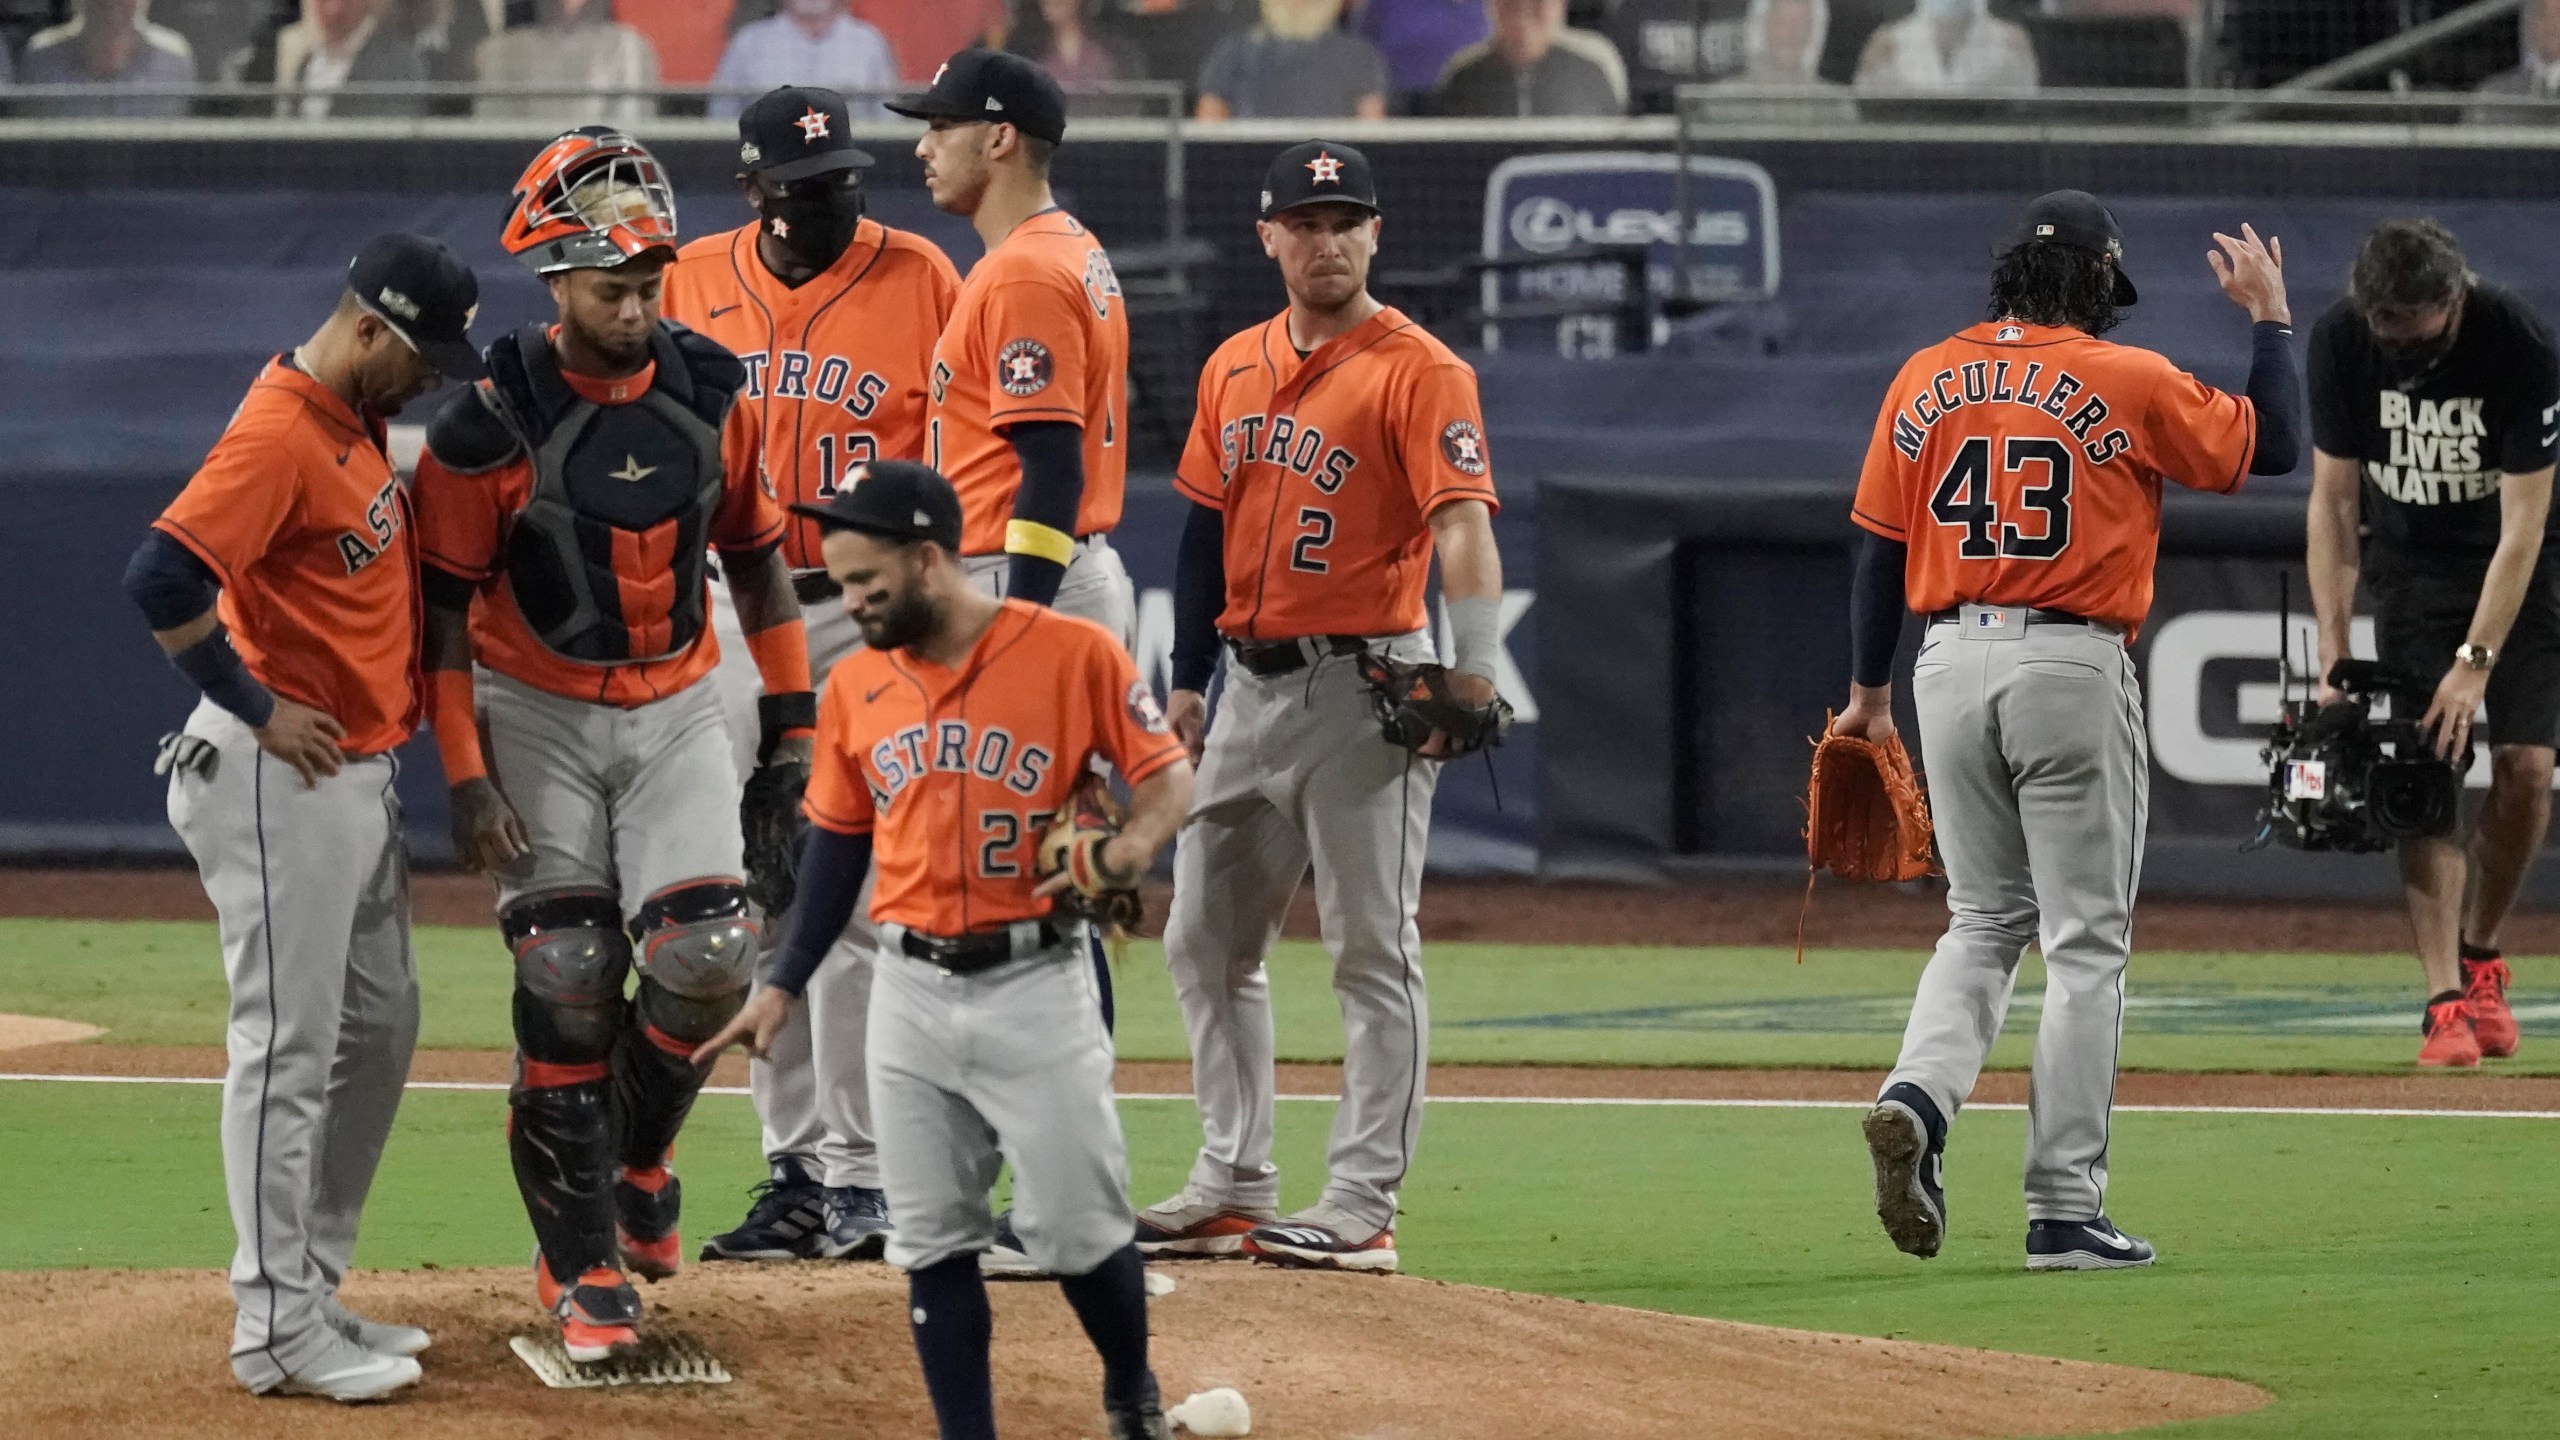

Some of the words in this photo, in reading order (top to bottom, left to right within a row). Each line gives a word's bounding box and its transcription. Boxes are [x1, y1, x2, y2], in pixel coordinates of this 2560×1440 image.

[2380, 389, 2488, 437] BLACK
[1219, 413, 1358, 495] STROS
[2389, 428, 2482, 473] LIVES
[1927, 436, 2074, 561] 43
[1290, 505, 1335, 573] 2
